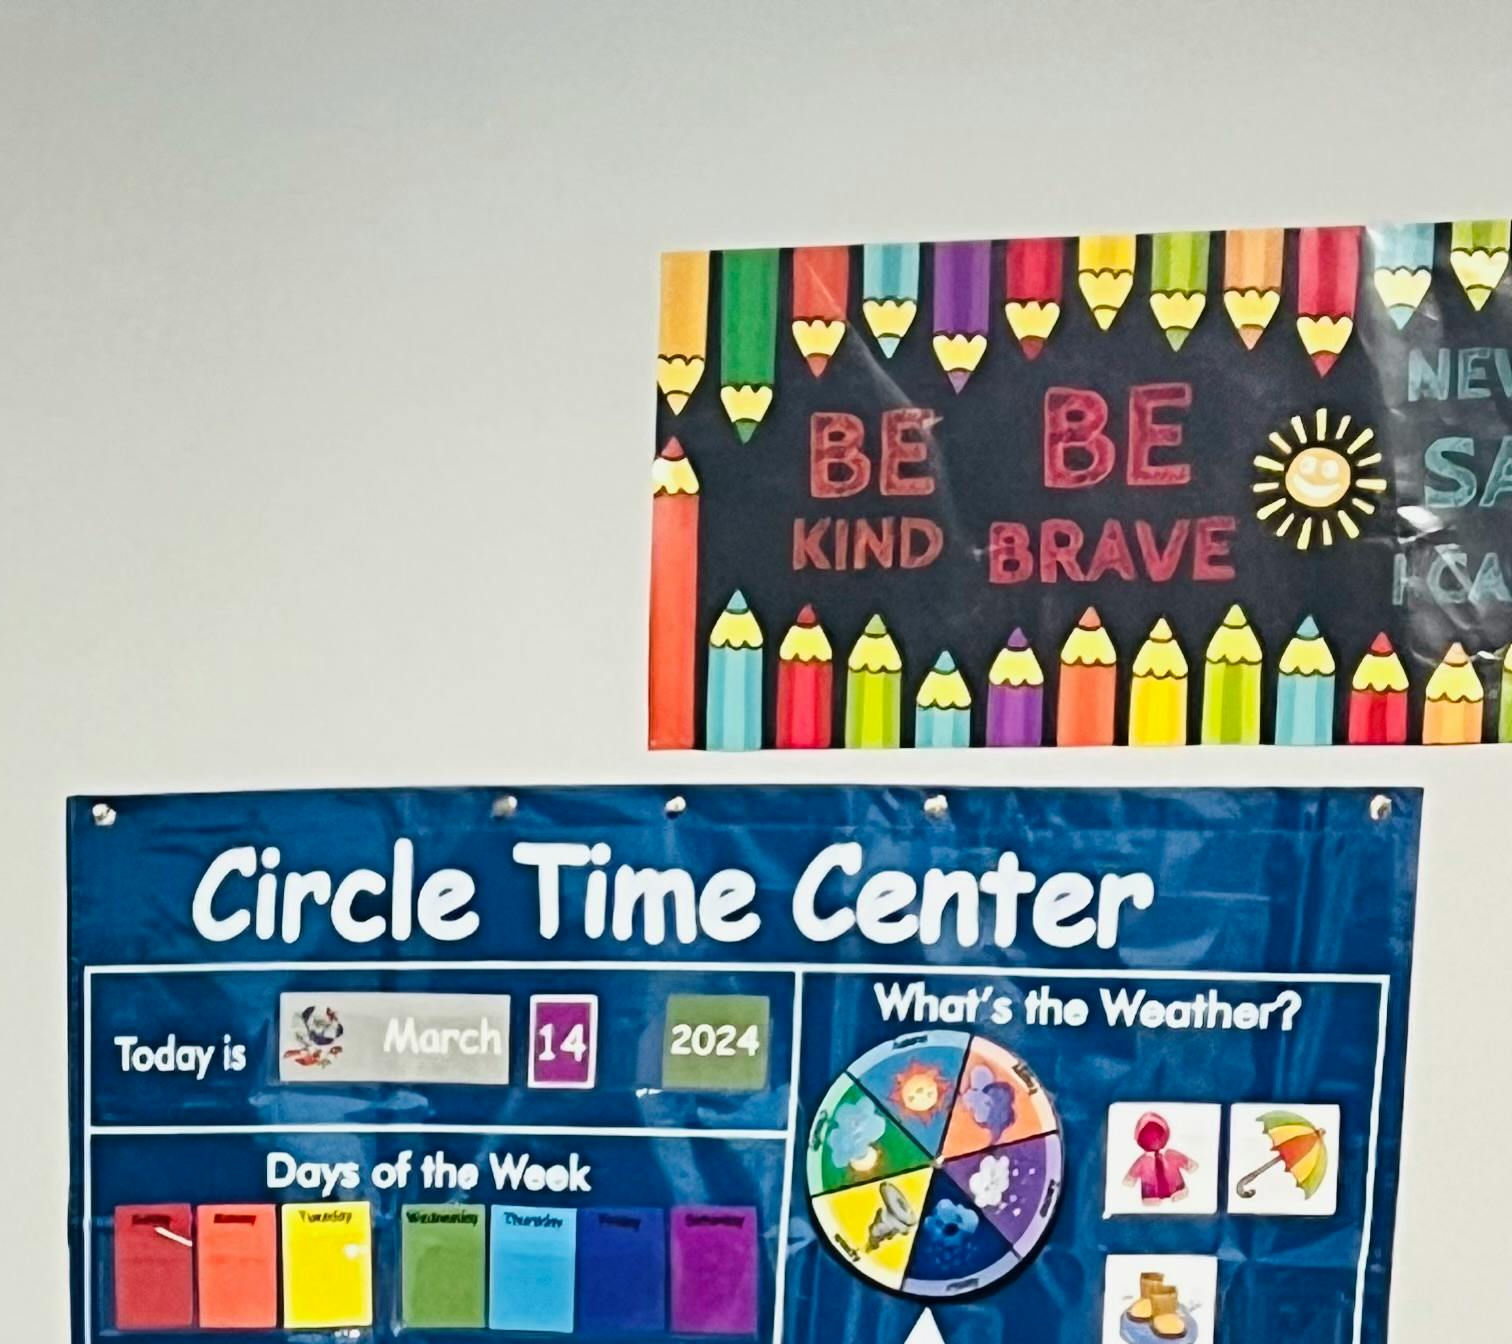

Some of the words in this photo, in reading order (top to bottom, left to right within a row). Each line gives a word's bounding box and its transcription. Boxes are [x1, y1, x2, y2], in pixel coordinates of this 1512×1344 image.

[809, 409, 937, 499] BE
[1042, 383, 1193, 489] BE
[792, 517, 944, 571] KIND
[988, 516, 1237, 585] BRAVE
[192, 838, 480, 943] Circle
[513, 841, 761, 945] Time
[792, 841, 1155, 950] Center
[874, 982, 1012, 1025] What's
[1025, 985, 1088, 1025] the
[1100, 989, 1303, 1031] Weather?
[114, 1035, 216, 1079] Today
[223, 1035, 246, 1072] is
[384, 1017, 502, 1056] March
[538, 1025, 587, 1061] 14
[670, 1024, 760, 1058] 2024
[266, 1153, 360, 1197] Days
[371, 1151, 412, 1190] of
[420, 1154, 478, 1191] the
[488, 1156, 592, 1193] Week
